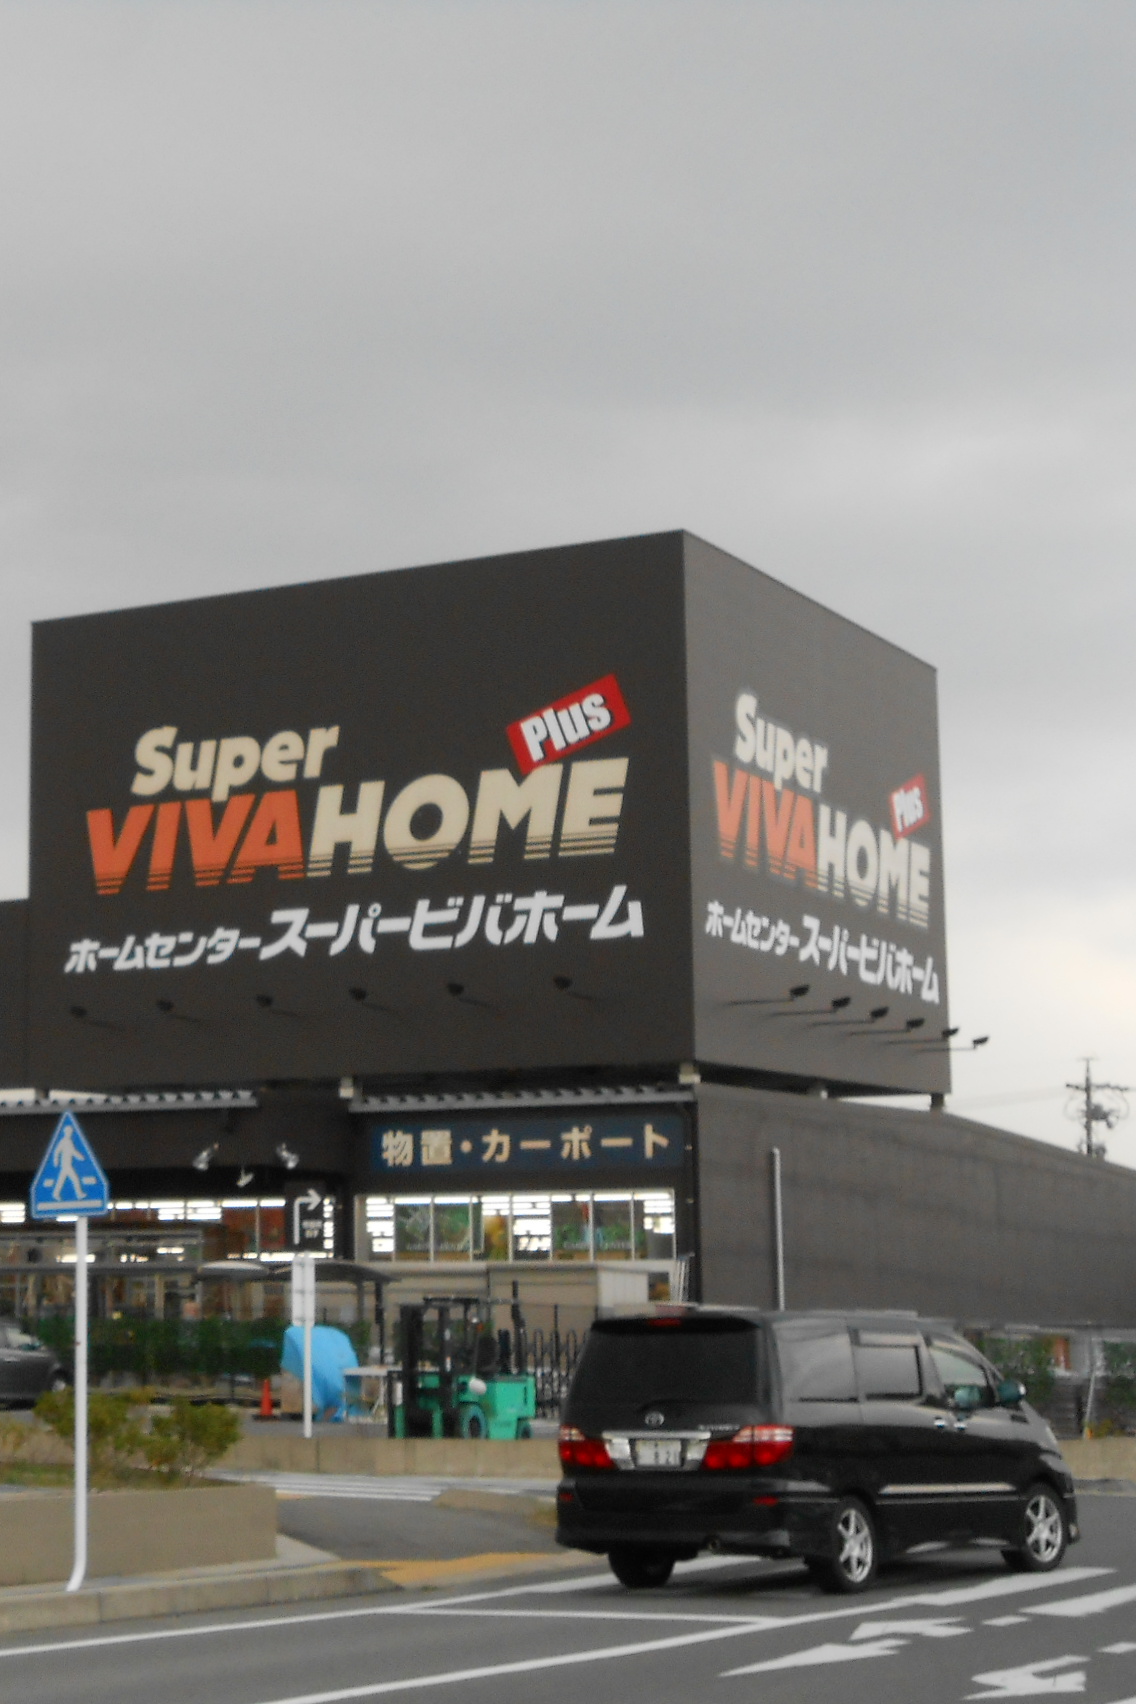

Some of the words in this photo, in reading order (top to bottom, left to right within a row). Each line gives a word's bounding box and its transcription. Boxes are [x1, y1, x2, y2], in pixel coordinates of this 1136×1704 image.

[131, 725, 339, 803] Super
[520, 692, 611, 762] Plus
[734, 692, 828, 793] Super
[382, 1123, 669, 1167] 物置・カーポート
